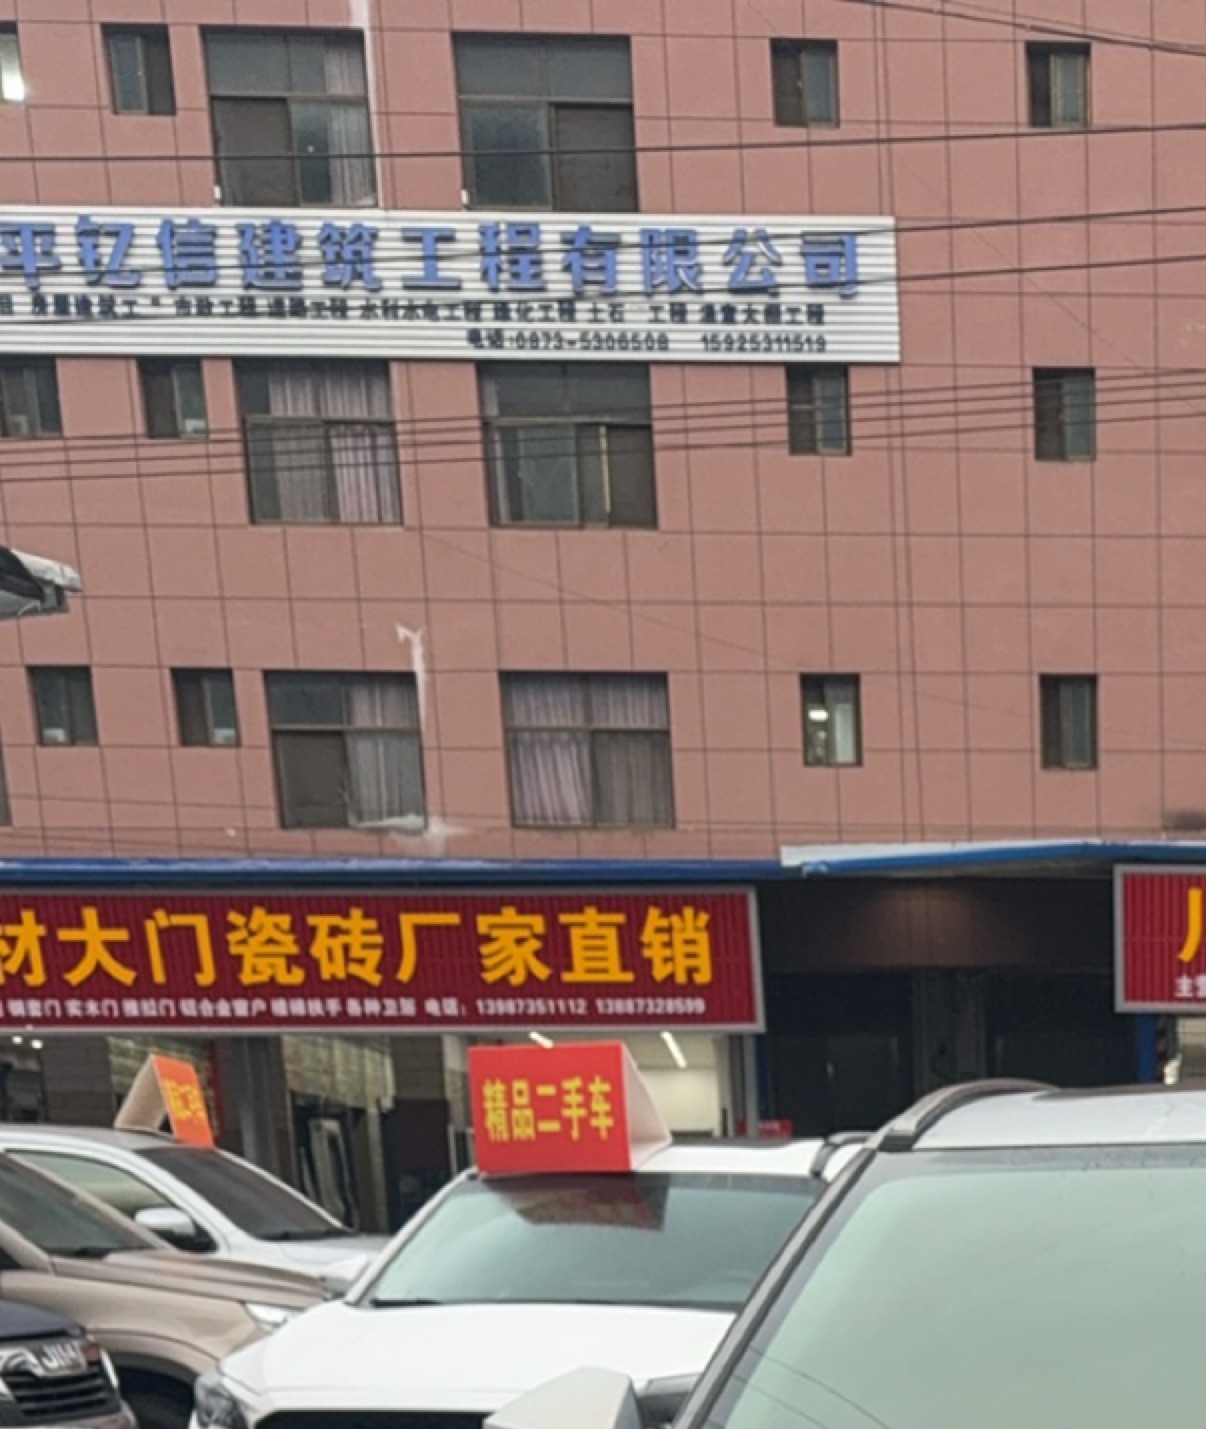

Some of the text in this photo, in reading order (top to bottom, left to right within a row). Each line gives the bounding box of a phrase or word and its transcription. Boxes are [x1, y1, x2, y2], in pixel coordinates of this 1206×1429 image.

[0, 215, 859, 298] 平亿信建筑工程有限公司
[0, 907, 714, 986] 材大门瓷砖厂家直销
[482, 1076, 614, 1141] 精品二手车
